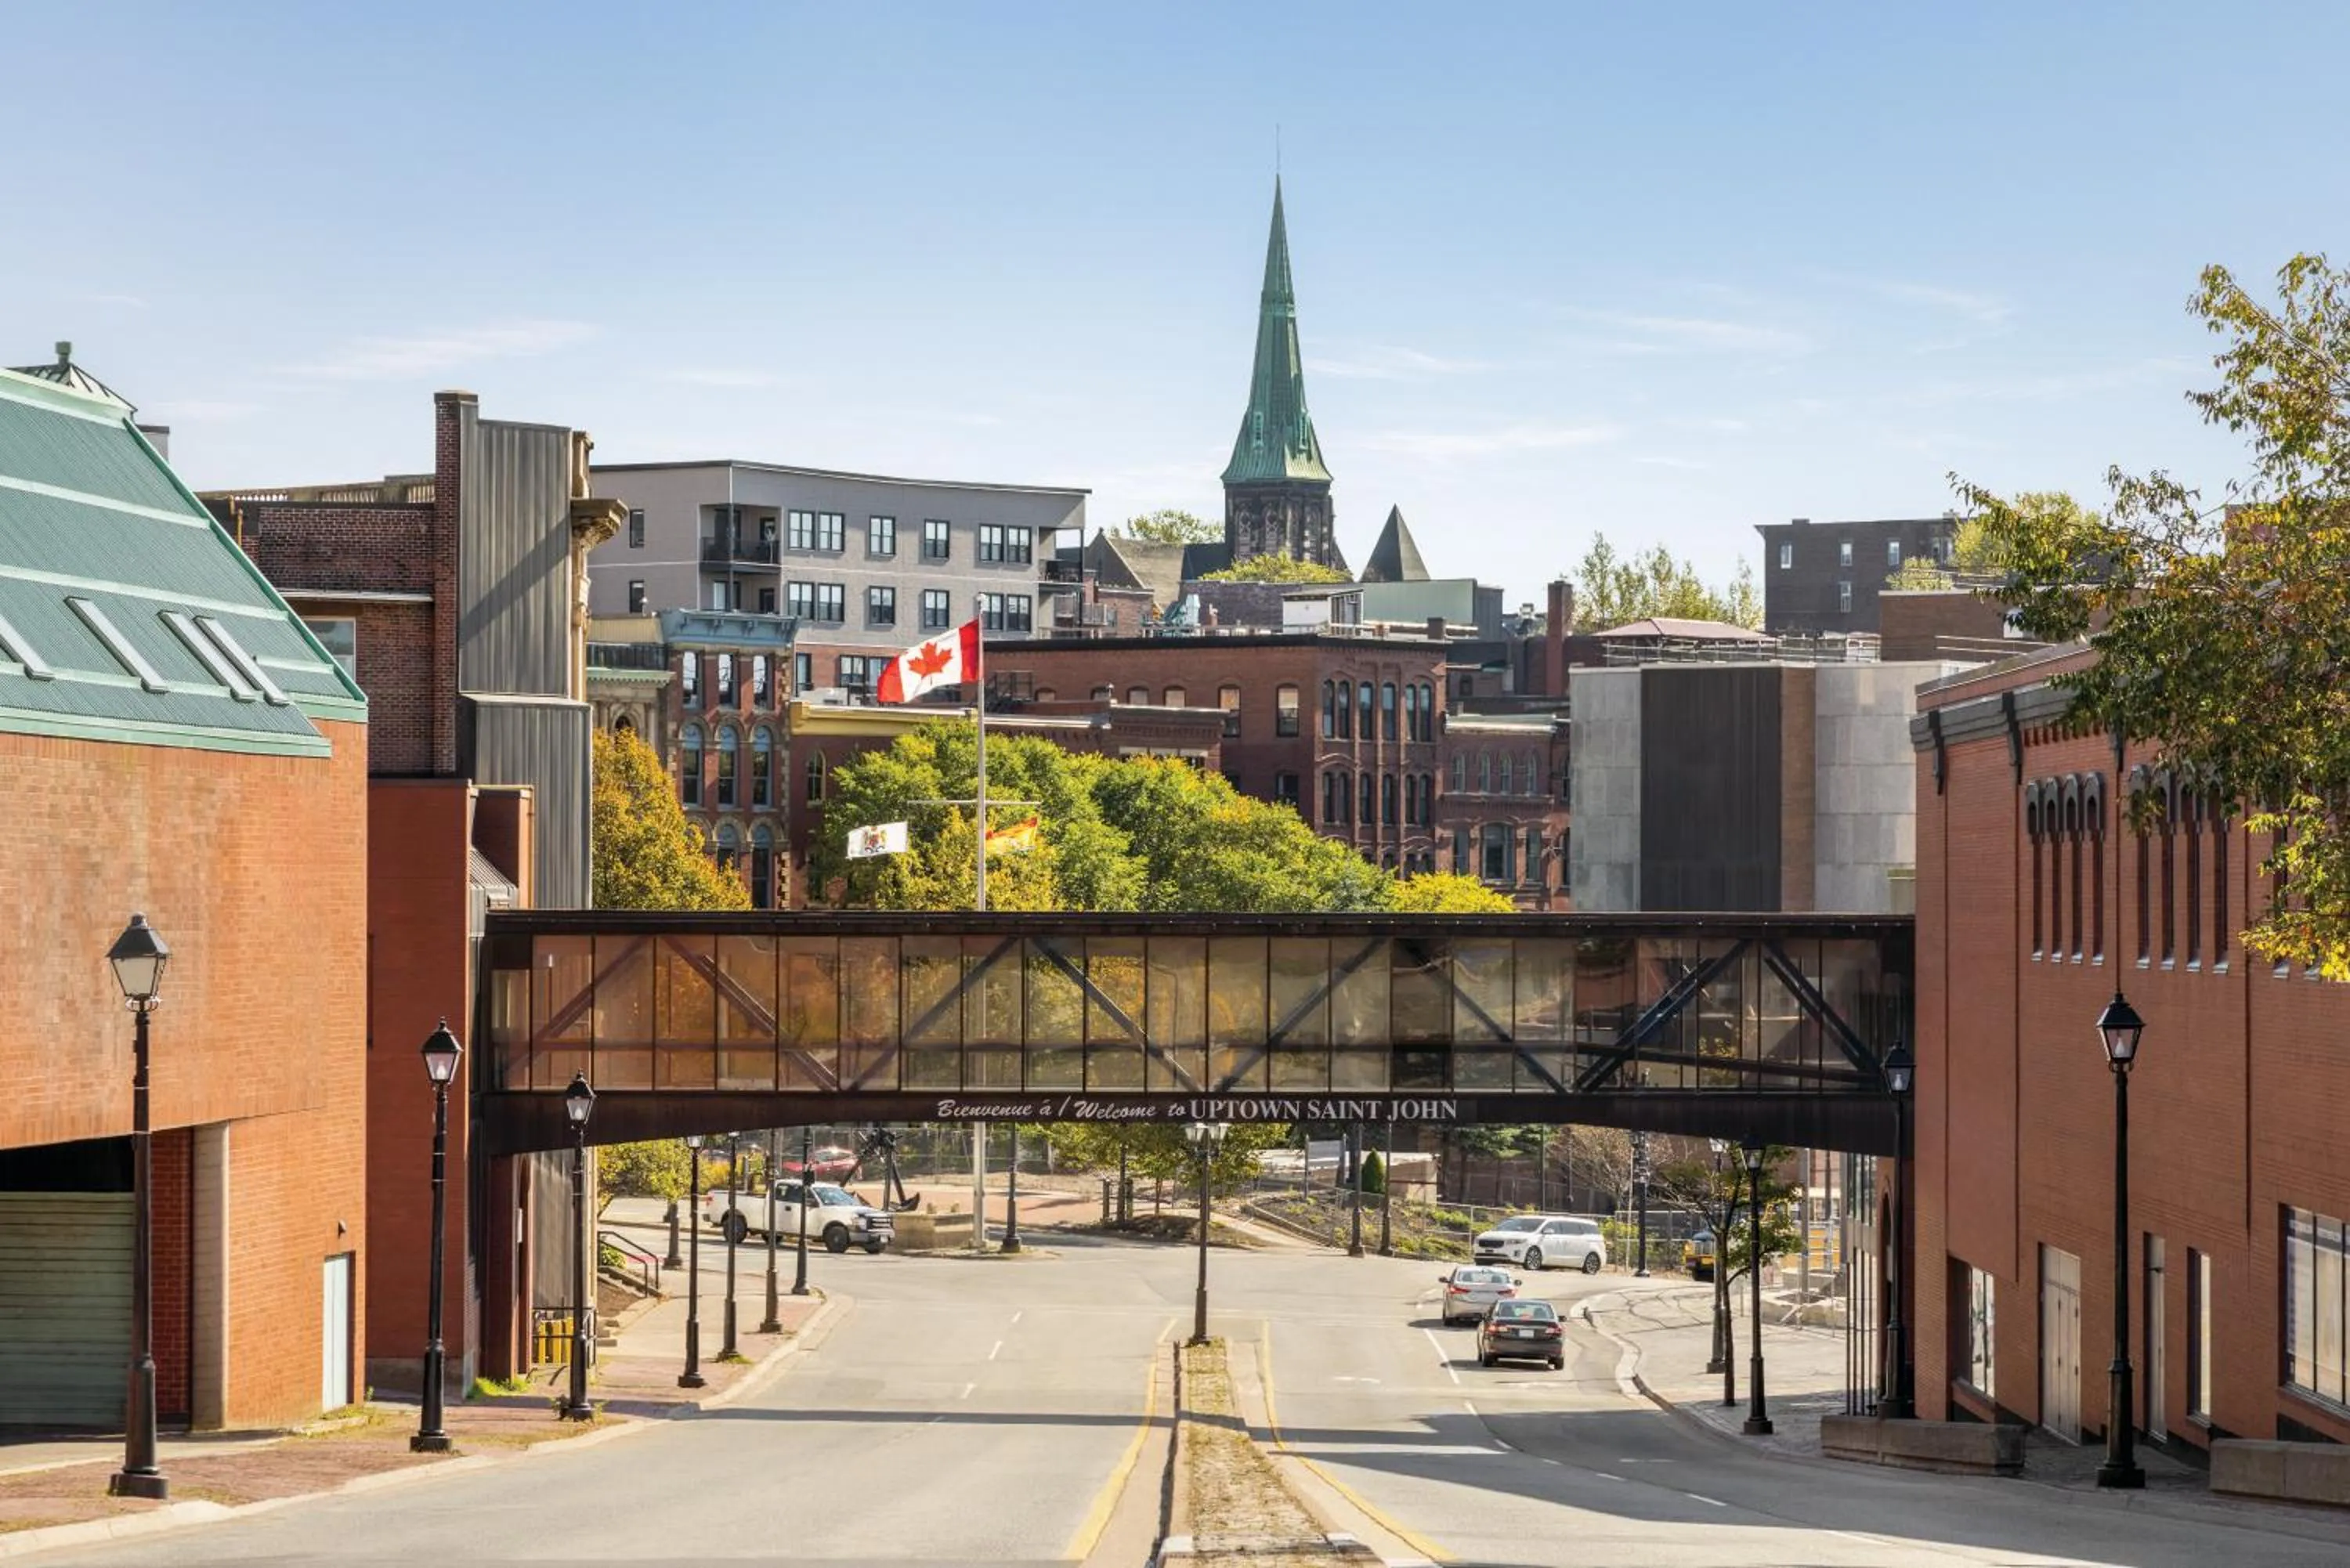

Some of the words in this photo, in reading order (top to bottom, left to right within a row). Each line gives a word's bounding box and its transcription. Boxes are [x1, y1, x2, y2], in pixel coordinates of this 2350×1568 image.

[937, 1099, 1032, 1118] Bienvenue
[1073, 1100, 1156, 1119] Welcome
[1167, 1102, 1186, 1117] to
[1190, 1099, 1301, 1119] UPTOWN
[1307, 1099, 1383, 1119] SAINT
[1386, 1099, 1457, 1122] JOHN
